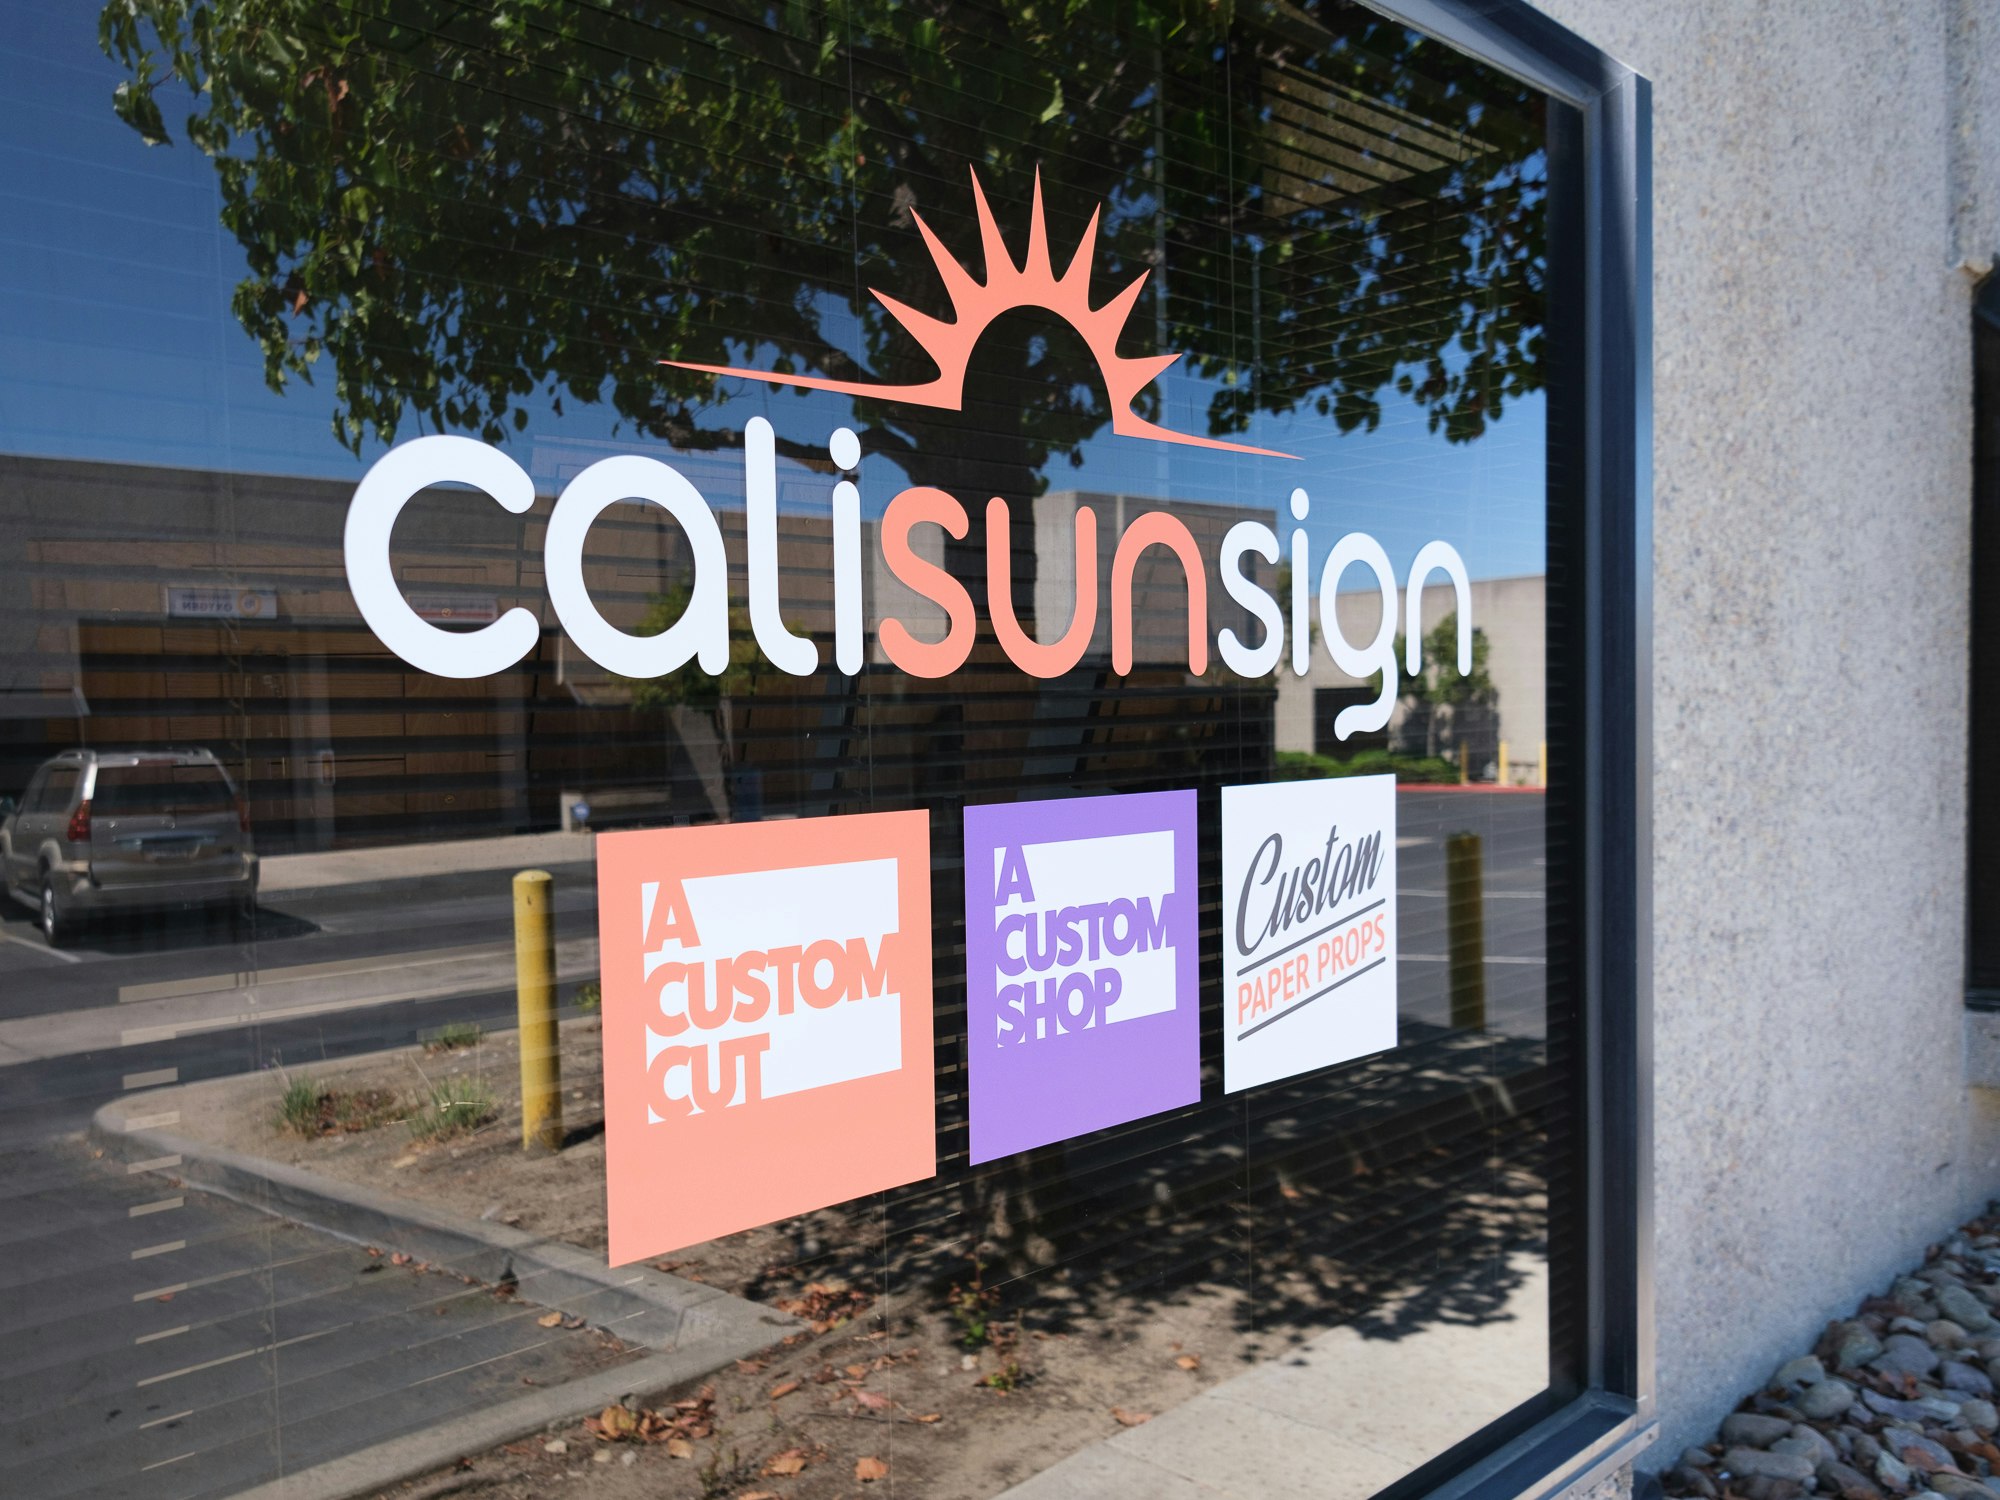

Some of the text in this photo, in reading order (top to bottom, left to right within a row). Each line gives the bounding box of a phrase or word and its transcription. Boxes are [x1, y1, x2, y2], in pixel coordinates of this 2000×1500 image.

[643, 877, 701, 953] A
[994, 844, 1035, 907] A
[1236, 824, 1385, 957] Custom
[994, 889, 1176, 977] CUSTOM
[1238, 913, 1386, 1025] PAPER PROPS
[643, 932, 901, 1037] CUSTOM
[996, 967, 1123, 1047] SHOP
[646, 1032, 770, 1123] CUT
